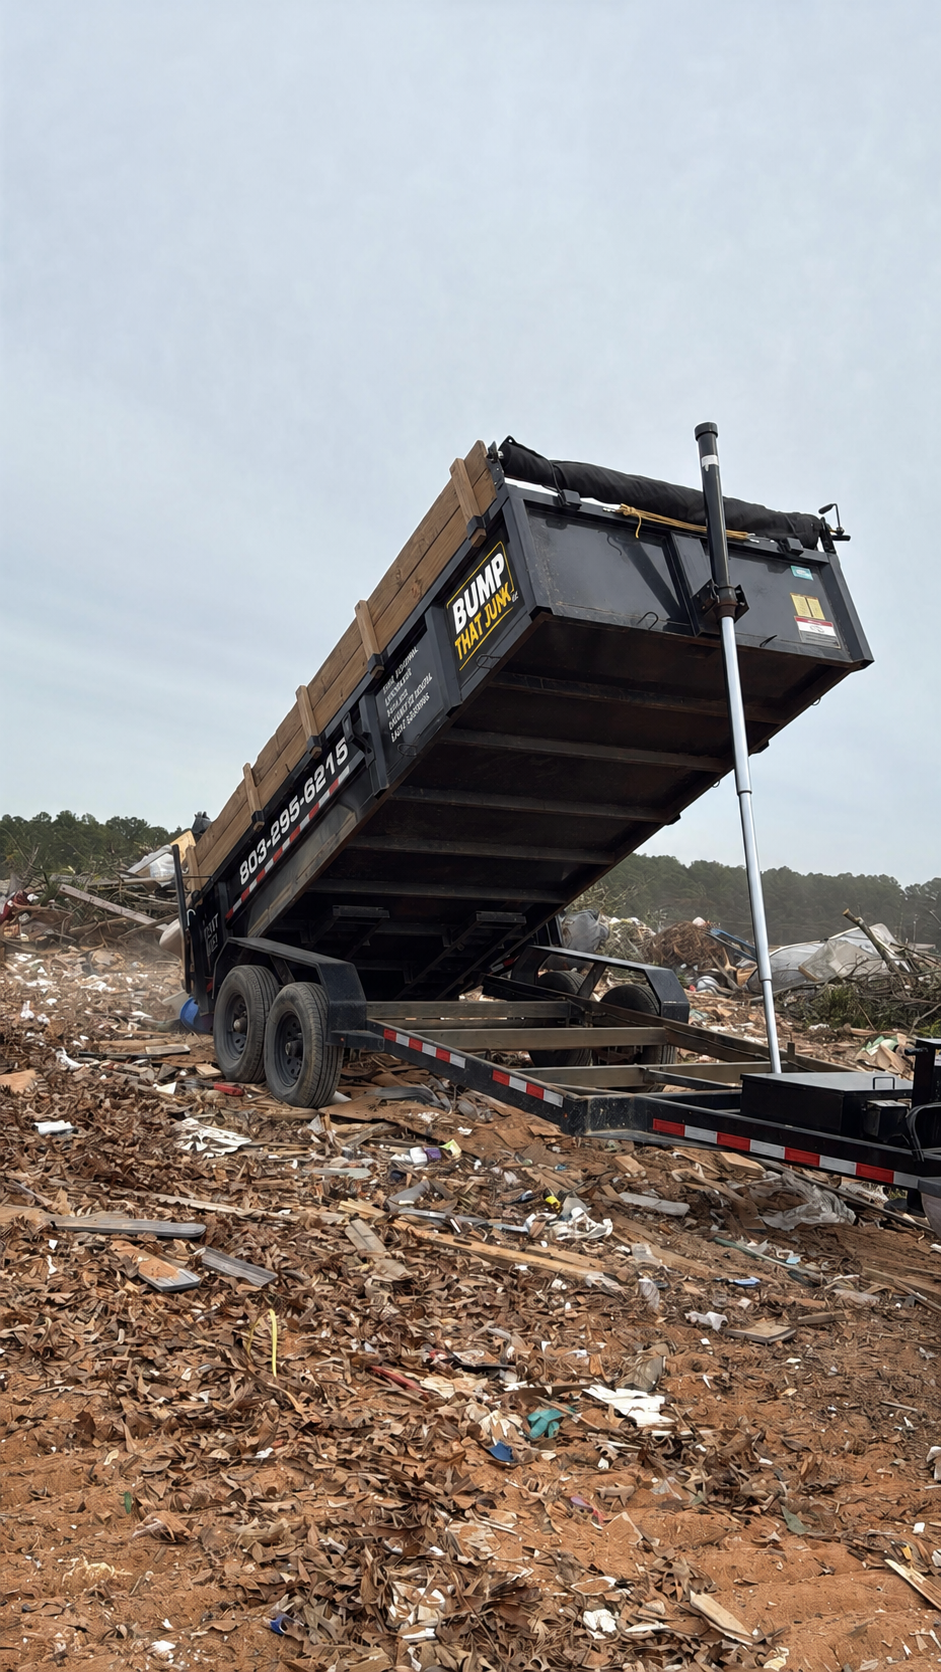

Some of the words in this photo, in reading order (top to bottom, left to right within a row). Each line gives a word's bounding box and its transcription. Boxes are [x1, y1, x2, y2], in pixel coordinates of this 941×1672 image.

[453, 553, 504, 634] BUMP
[455, 612, 482, 660] THAT
[484, 582, 511, 628] JUNK
[239, 737, 348, 885] 803-295-6215
